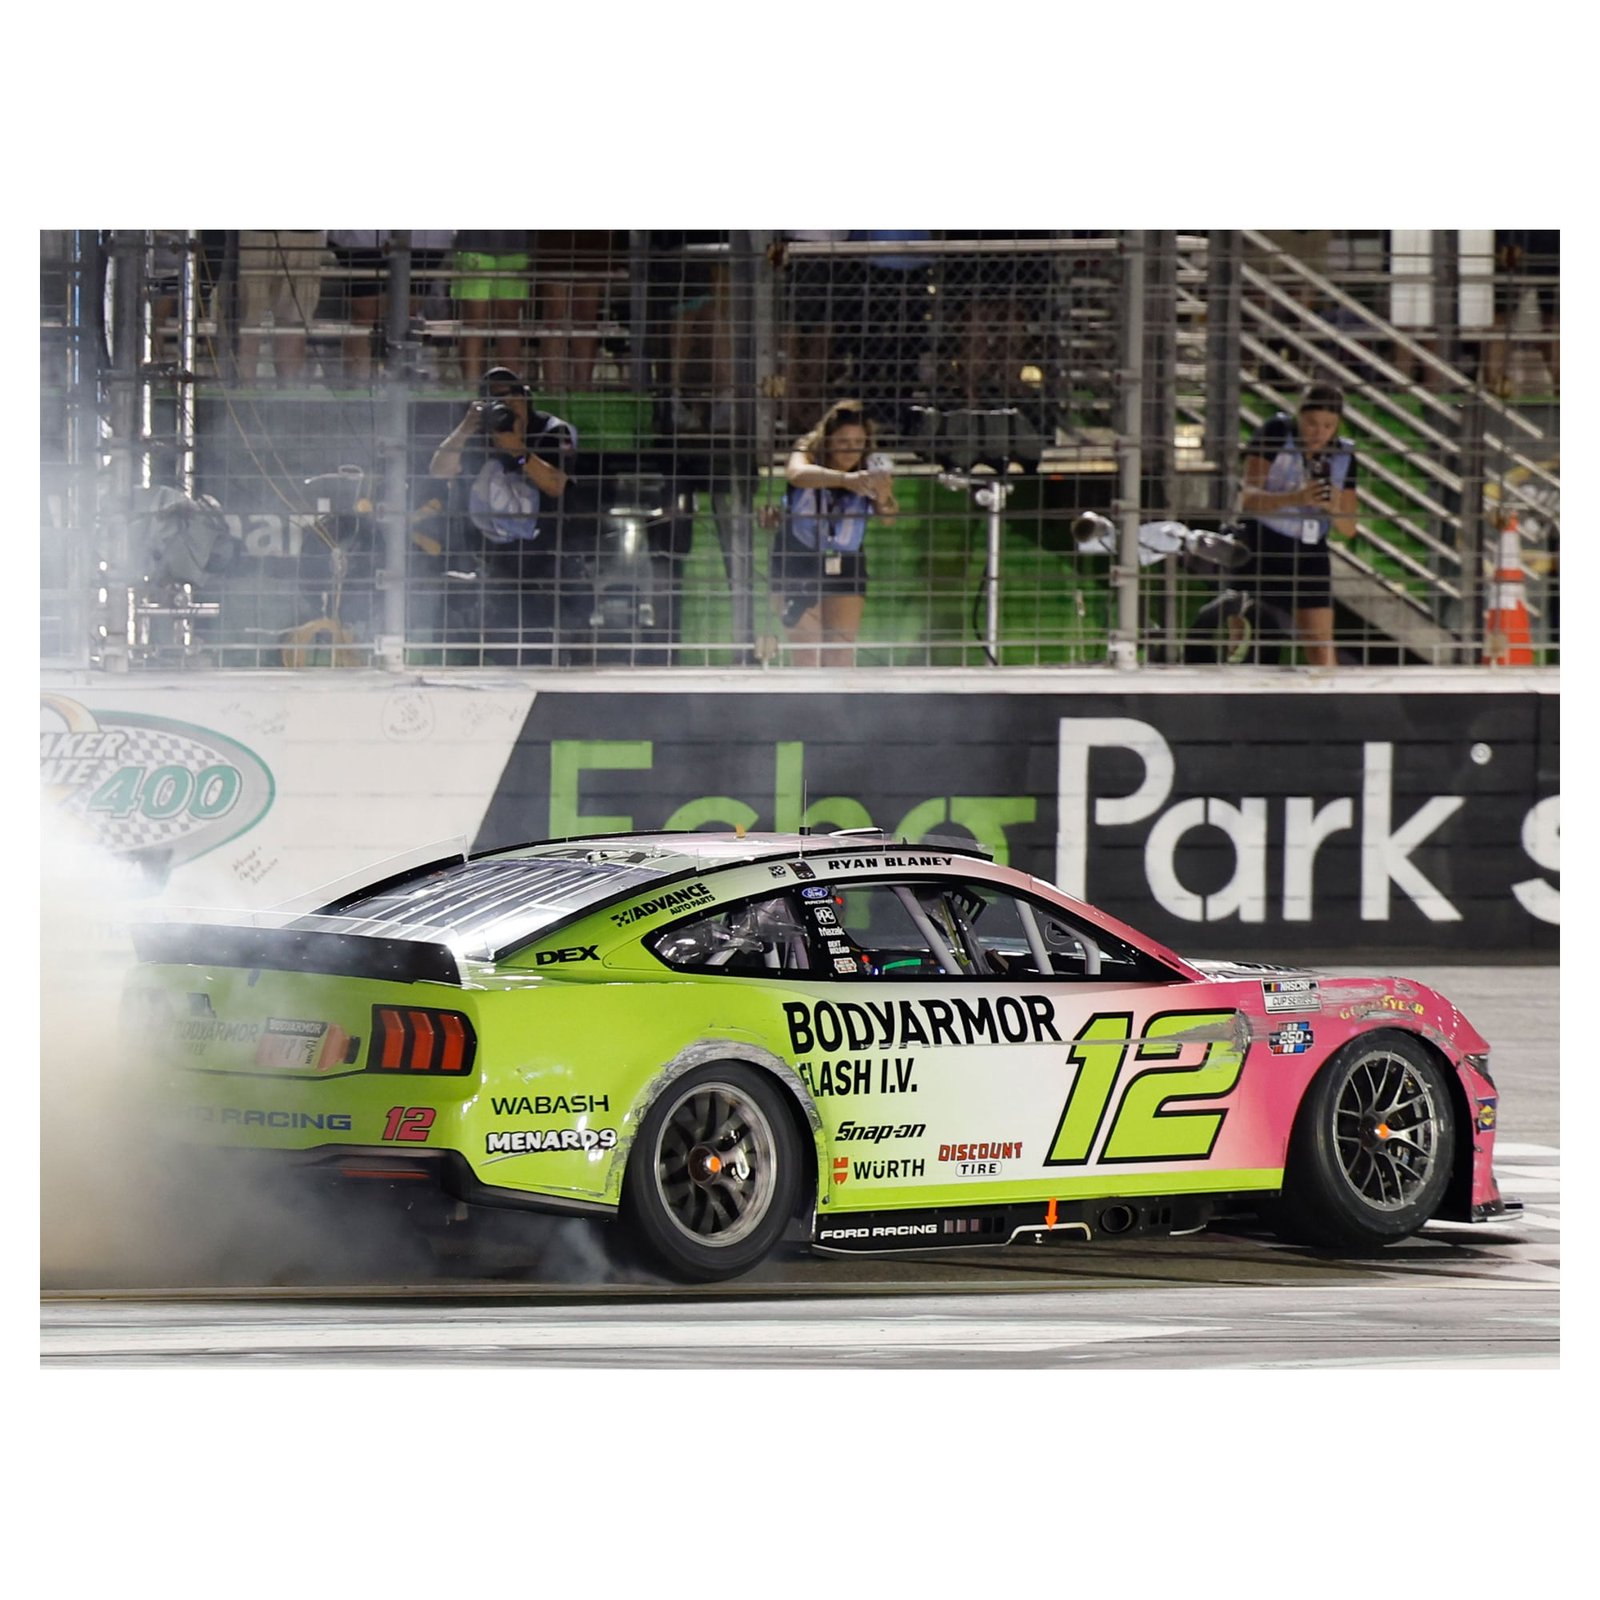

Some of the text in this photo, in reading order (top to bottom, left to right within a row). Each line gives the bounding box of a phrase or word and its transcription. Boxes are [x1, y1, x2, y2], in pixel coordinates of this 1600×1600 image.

[87, 765, 242, 820] 400
[828, 857, 953, 870] RYAN BLANEY
[634, 882, 711, 921] ADVANCE
[669, 894, 716, 915] AUTO PARTS
[818, 926, 845, 937] Mazak
[535, 945, 601, 966] DEX
[1280, 981, 1311, 992] NASCAR
[1272, 996, 1287, 1006] CUP
[782, 995, 1064, 1055] BODYARMOR
[1278, 1030, 1305, 1045] 250
[880, 1058, 918, 1094] I.V.
[1042, 1008, 1249, 1166] 12
[491, 1094, 610, 1115] WABASH
[222, 1108, 352, 1131] RACING
[381, 1106, 437, 1142] 12
[834, 1121, 927, 1145] Snap-on
[938, 1142, 1023, 1162] DISCOUNT
[960, 1163, 998, 1175] TIRE
[820, 1224, 938, 1240] FORD RACING
